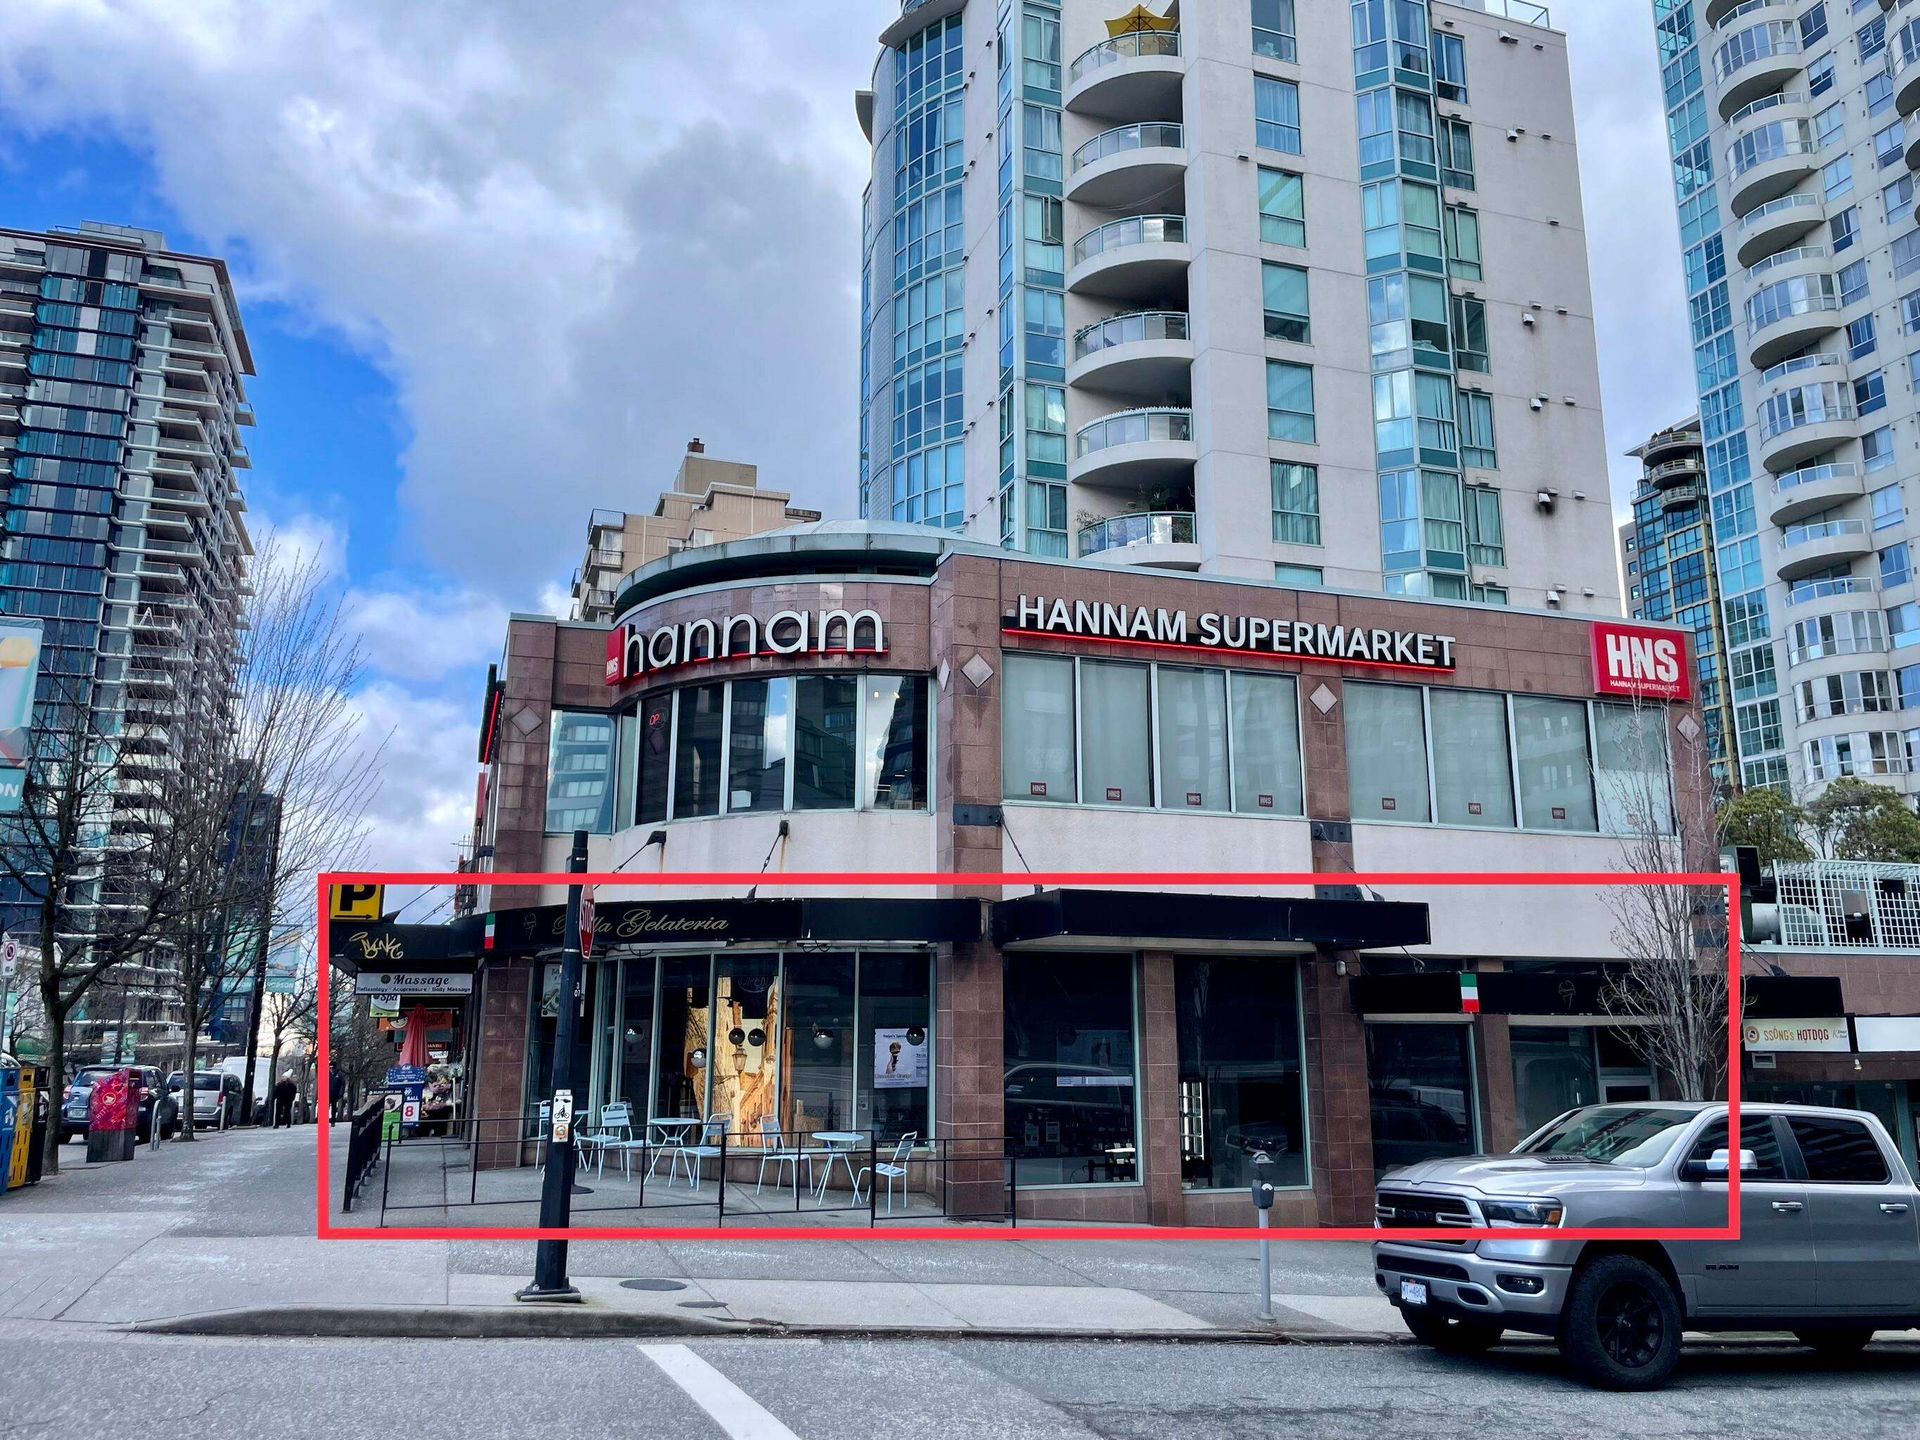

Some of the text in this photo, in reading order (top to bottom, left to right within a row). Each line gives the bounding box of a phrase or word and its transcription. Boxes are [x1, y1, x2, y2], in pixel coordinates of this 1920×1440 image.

[623, 609, 884, 678] hannam
[1019, 594, 1456, 666] HANNAM SUPERMARKET
[1605, 634, 1679, 683] HNS
[1032, 784, 1045, 793] HNS
[339, 884, 377, 911] P
[551, 908, 729, 938] lla Gelateria
[580, 900, 595, 934] STOP
[393, 974, 450, 987] Massage
[1797, 1029, 1829, 1043] HOTDOG
[404, 1105, 414, 1117] 8
